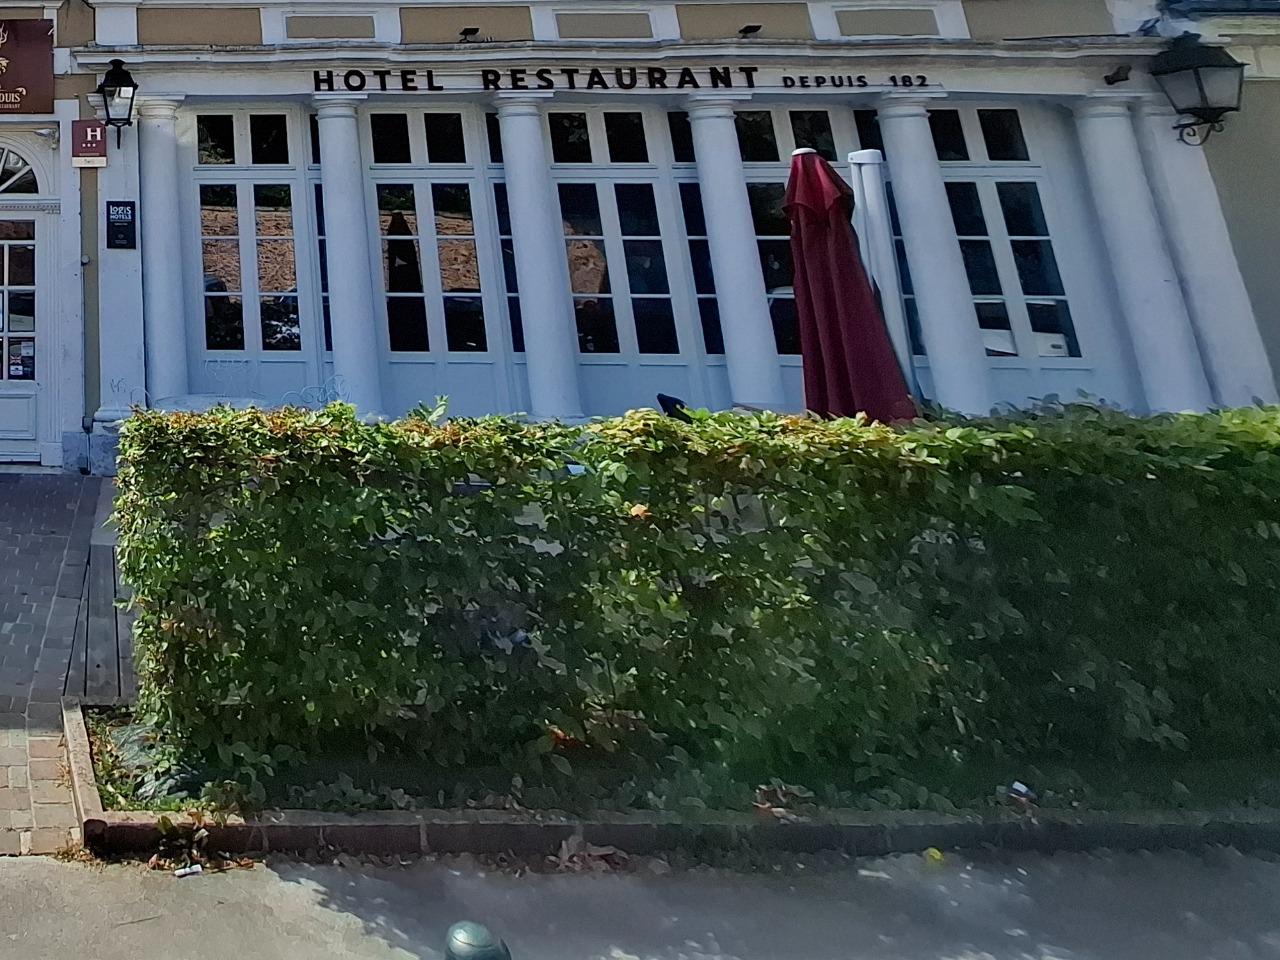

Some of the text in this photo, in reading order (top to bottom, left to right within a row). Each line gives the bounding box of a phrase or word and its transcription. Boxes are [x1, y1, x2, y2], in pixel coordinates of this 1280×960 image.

[313, 66, 929, 92] HOTEL RESTAURANT DEPUIS 182
[86, 127, 101, 141] H
